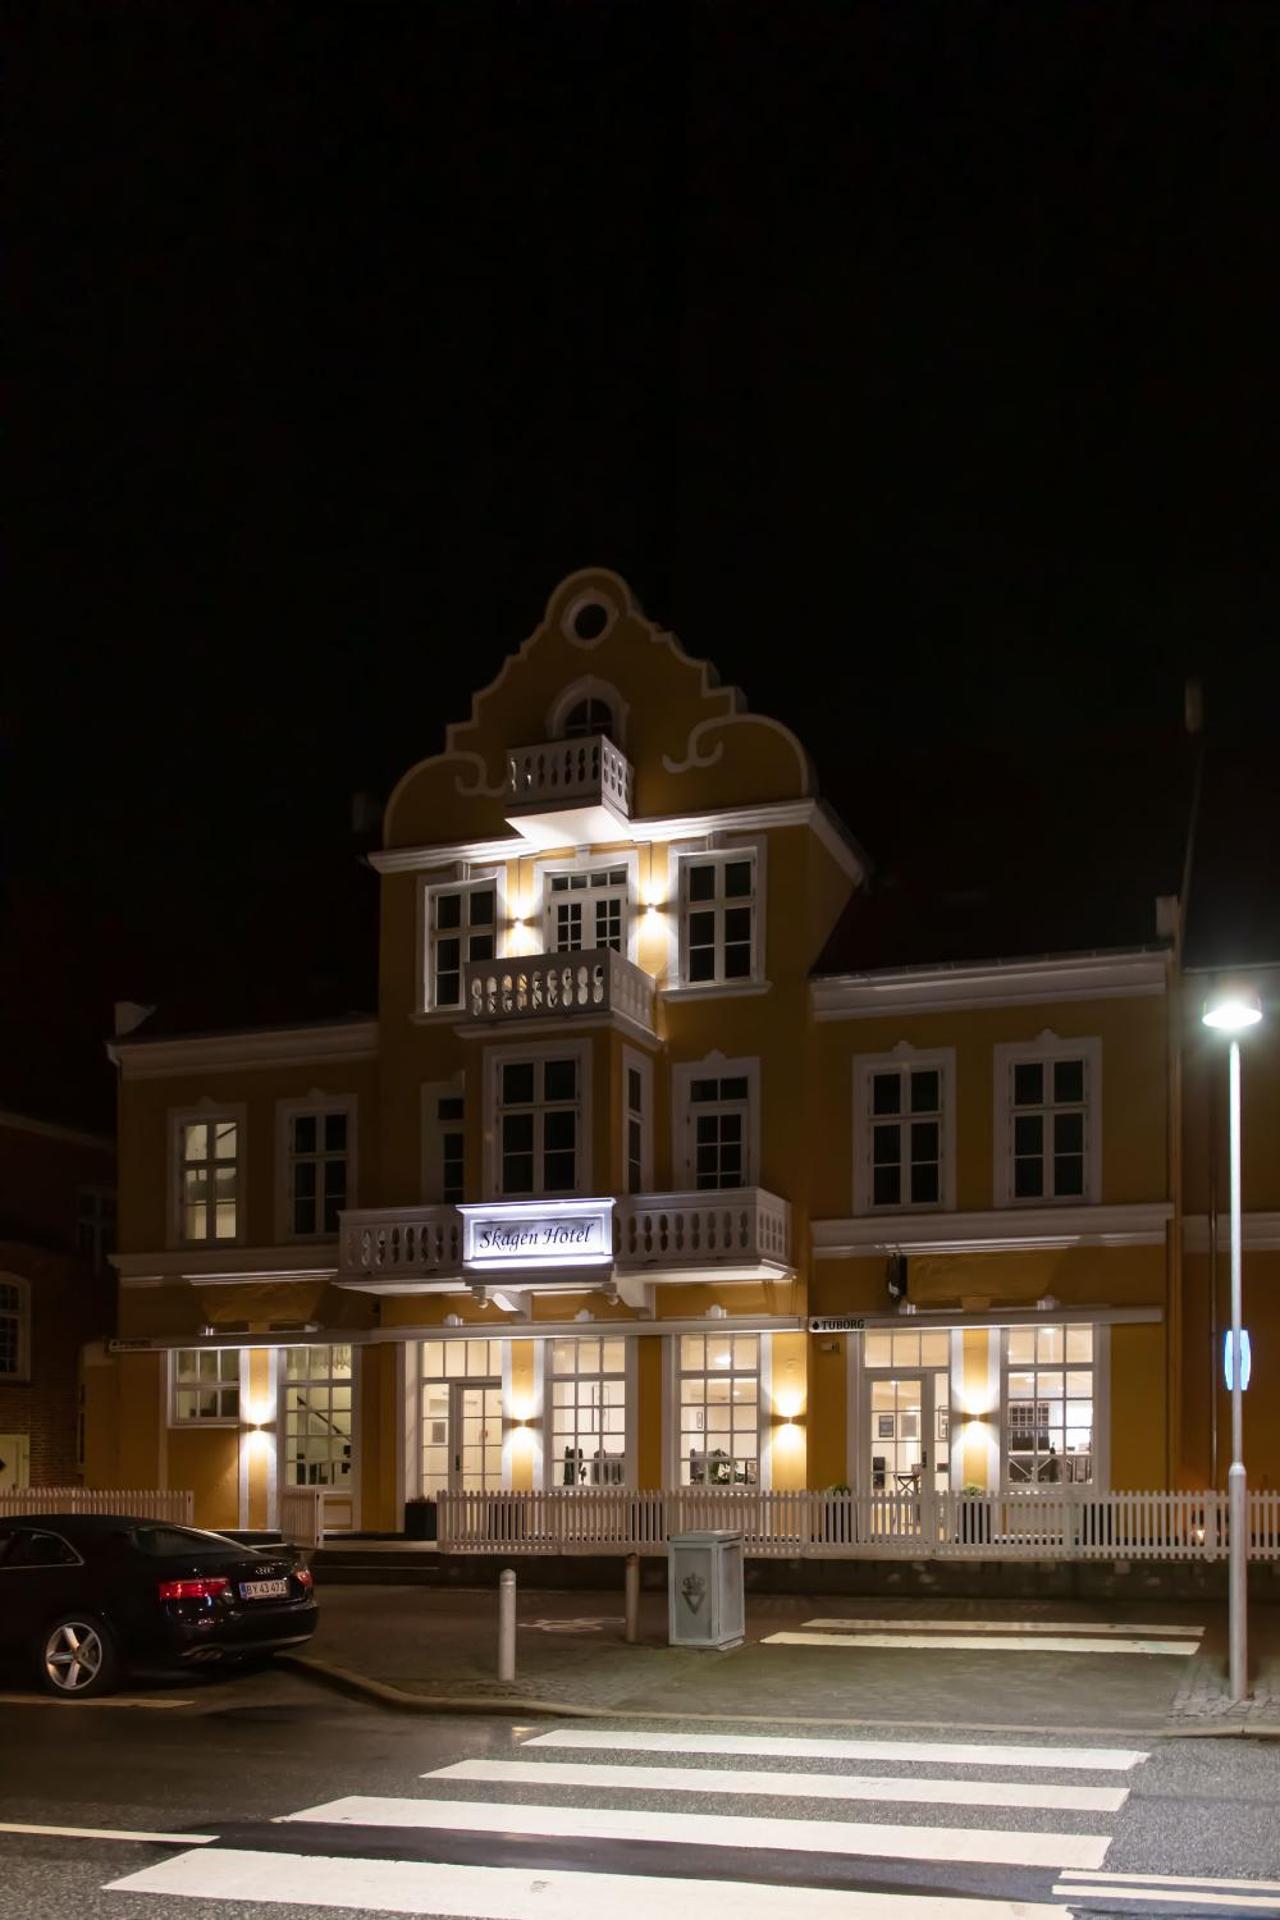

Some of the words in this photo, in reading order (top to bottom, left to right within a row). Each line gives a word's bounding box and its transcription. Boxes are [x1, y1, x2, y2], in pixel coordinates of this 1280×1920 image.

[479, 1227, 538, 1252] Skagen
[541, 1223, 594, 1246] Hotel
[822, 1319, 864, 1330] TUBORG
